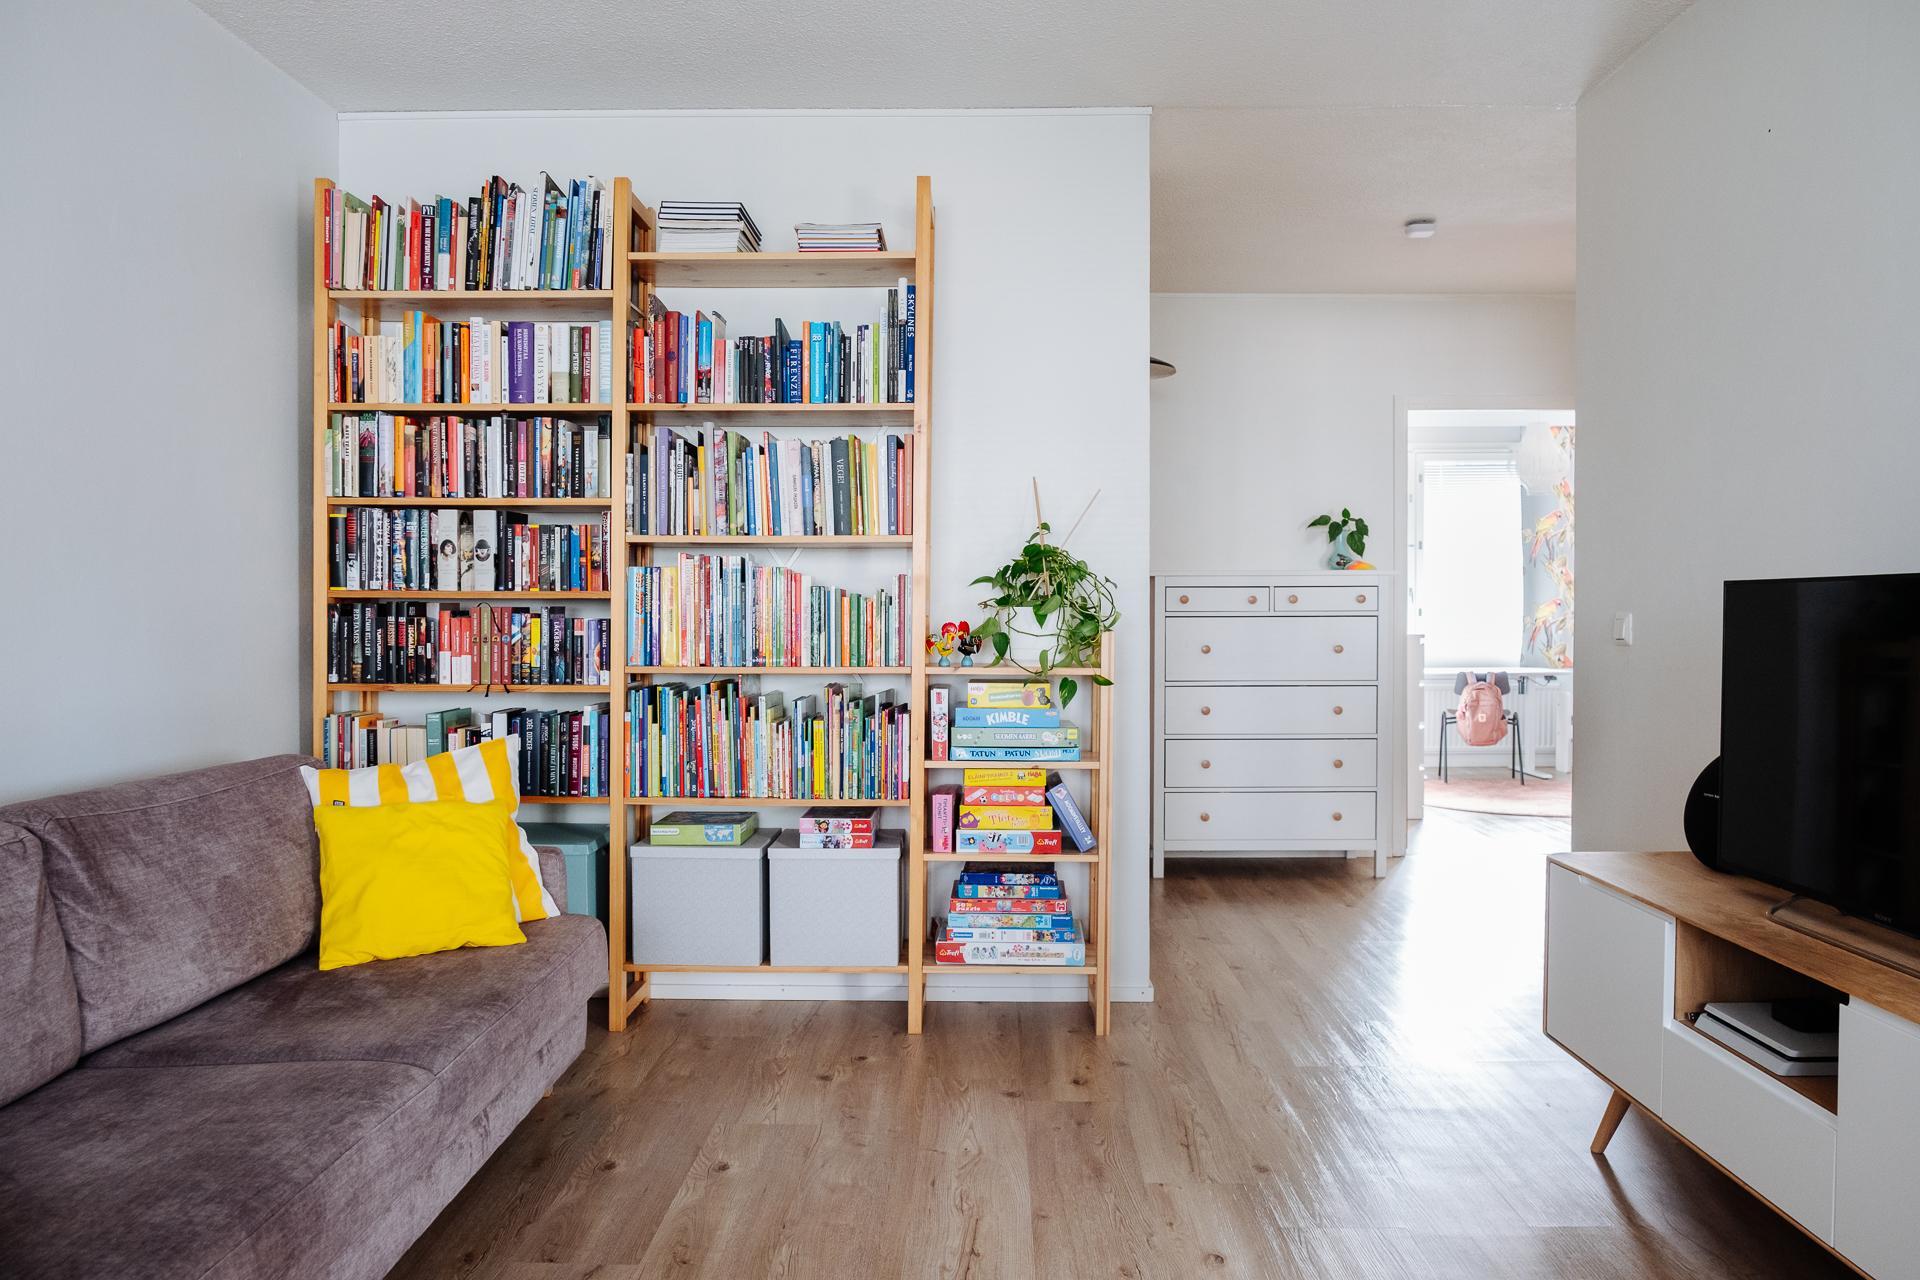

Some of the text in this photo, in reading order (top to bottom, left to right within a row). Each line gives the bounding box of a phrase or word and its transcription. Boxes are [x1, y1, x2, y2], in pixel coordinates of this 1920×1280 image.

[907, 293, 915, 338] SKYLINES
[790, 348, 798, 396] FIRENZE
[431, 435, 439, 464] ATKINSON
[836, 458, 845, 484] VEGE!
[352, 621, 360, 644] JAMES
[387, 621, 396, 647] LARSSON
[397, 620, 407, 647] LARSSON
[553, 621, 561, 652] LÄCKBERG
[985, 711, 1030, 726] KIMBLE
[526, 731, 534, 751] DICKER
[571, 734, 580, 751] YOUNG
[970, 750, 997, 758] TATUN
[1004, 750, 1031, 758] PATUN
